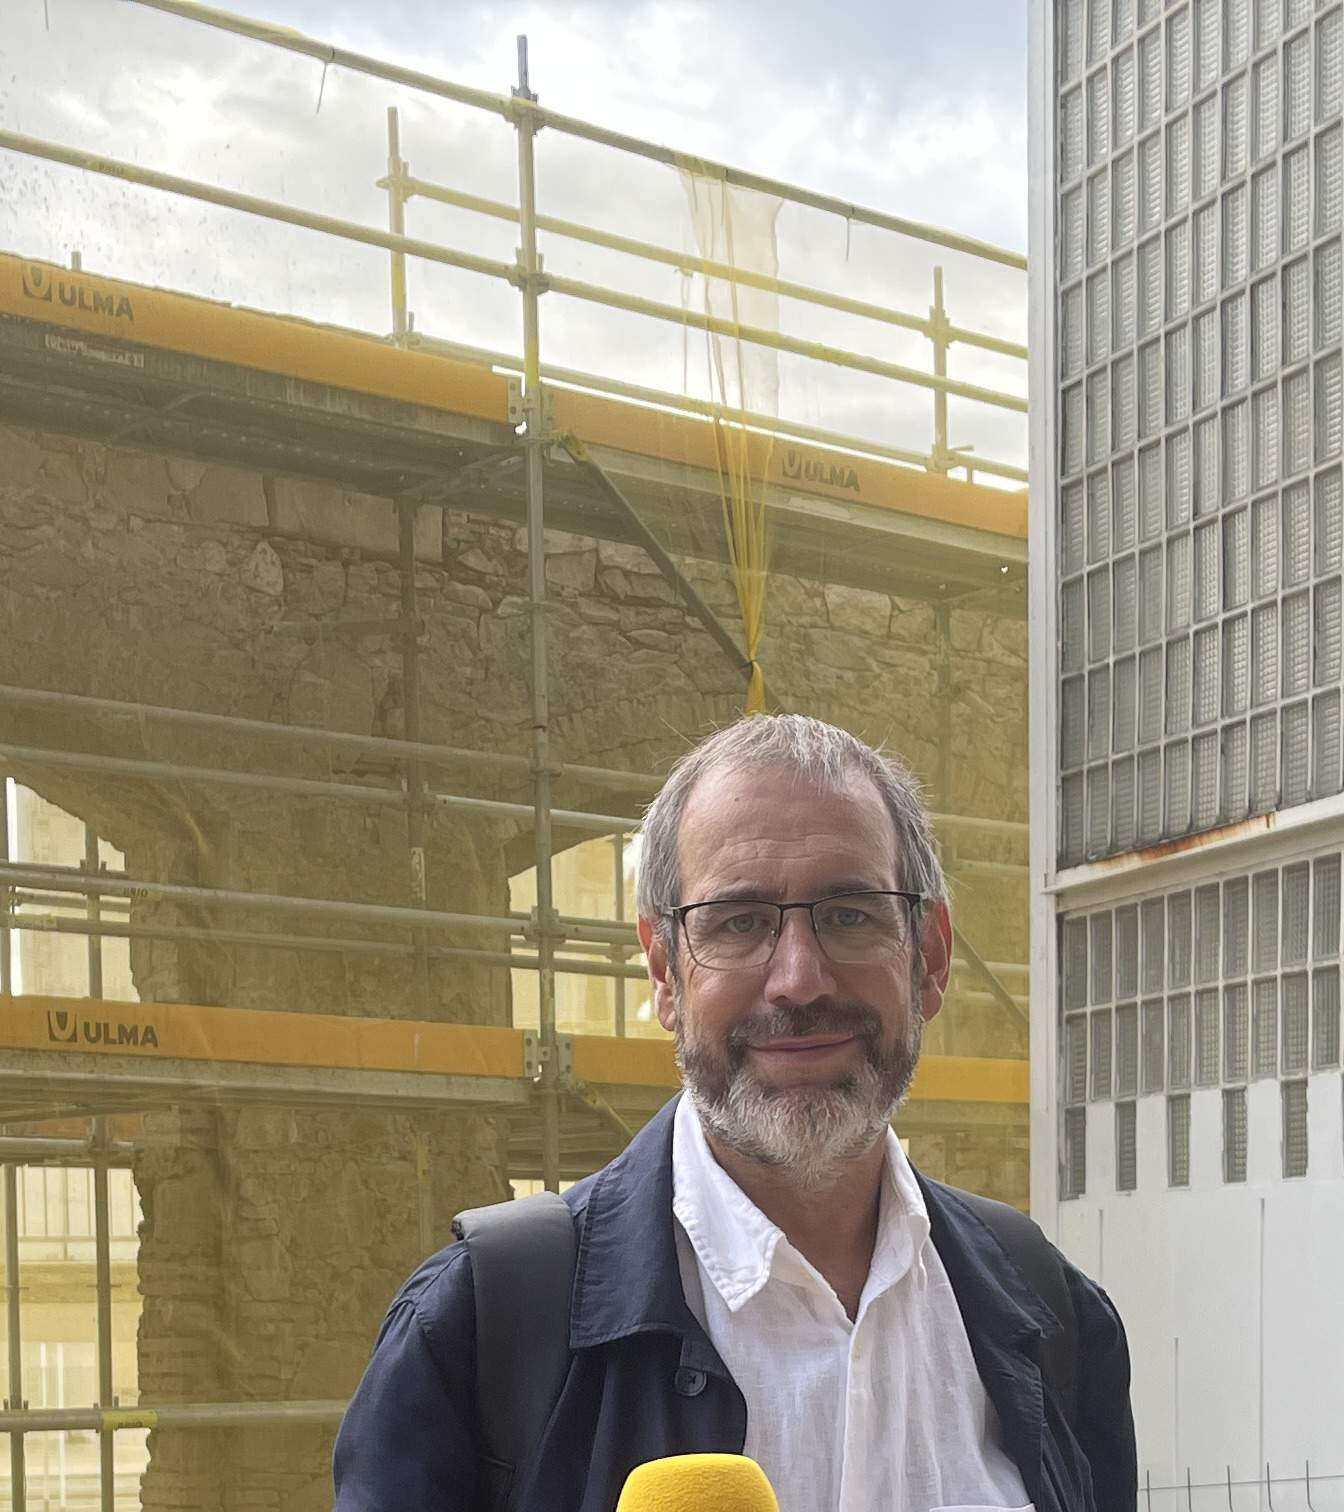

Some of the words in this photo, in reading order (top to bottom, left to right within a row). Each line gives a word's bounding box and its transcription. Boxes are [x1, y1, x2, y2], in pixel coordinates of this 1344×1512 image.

[58, 281, 134, 322] ULMA
[805, 460, 861, 493] ULMA
[83, 1020, 159, 1049] ULMA
